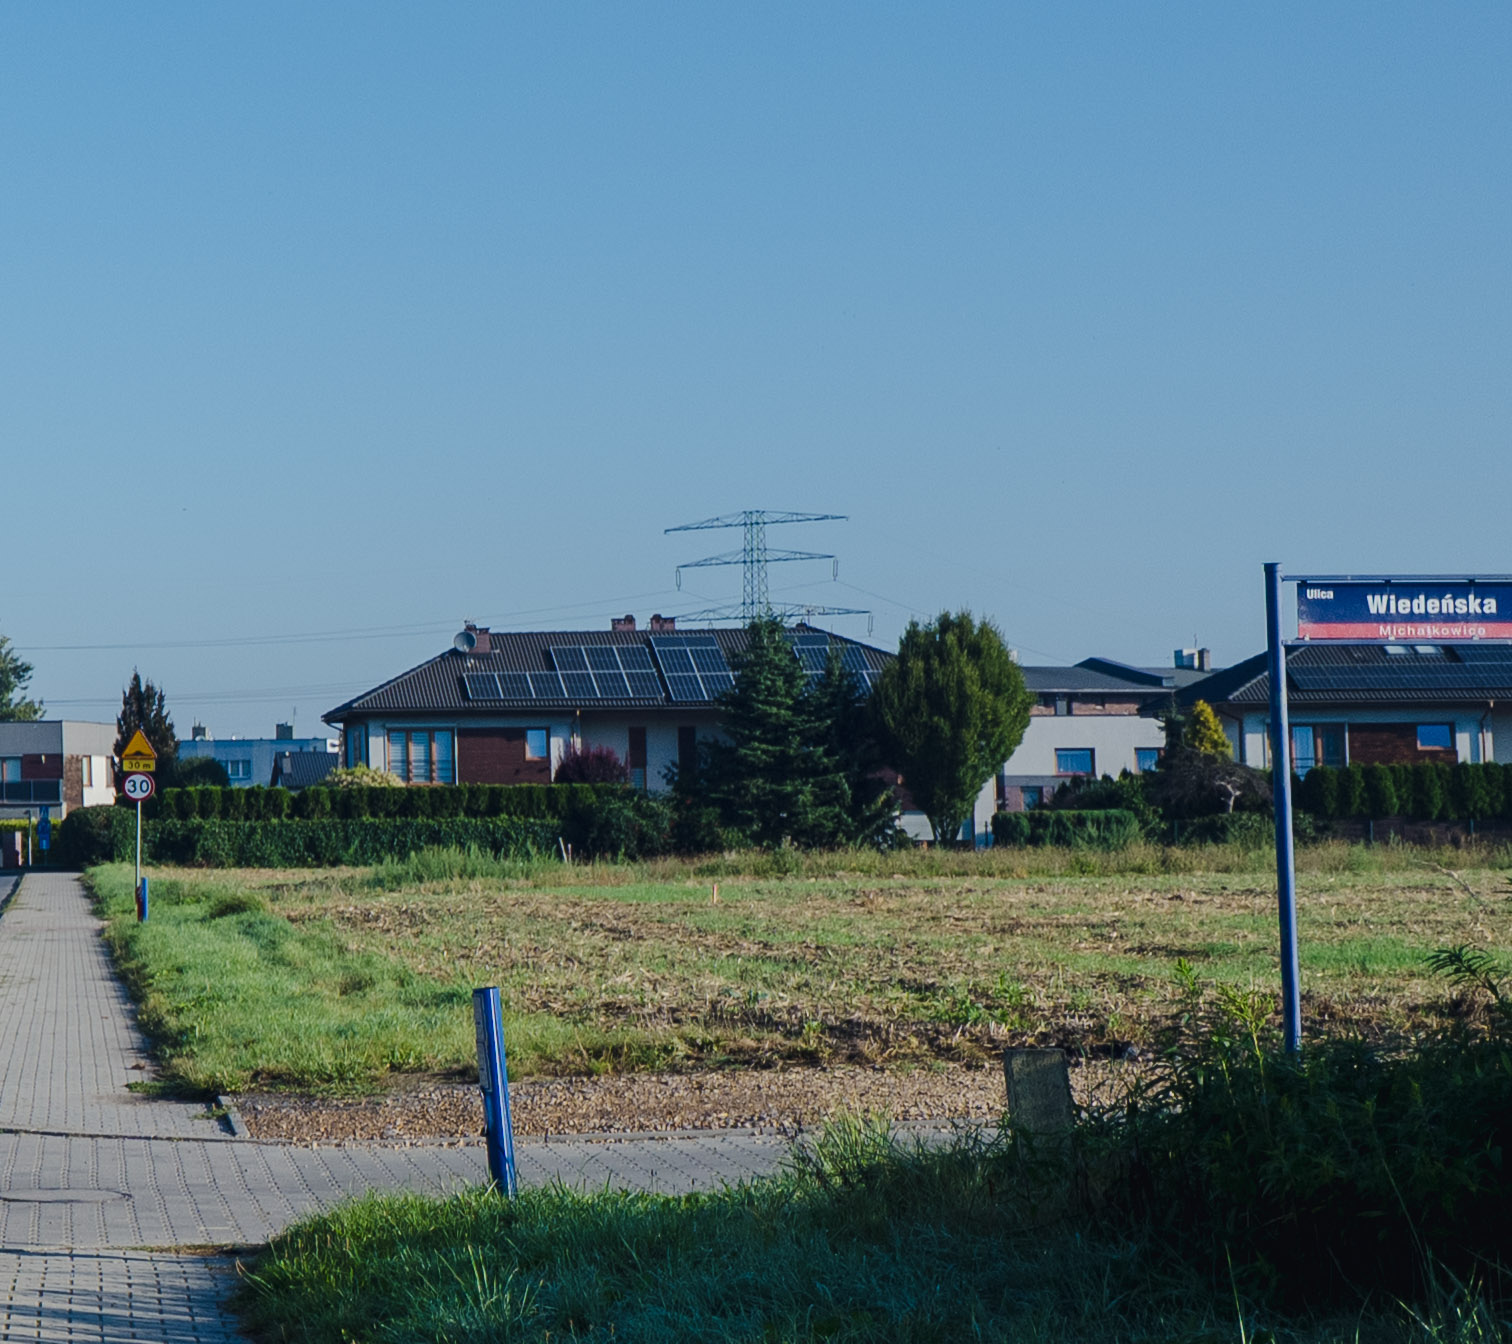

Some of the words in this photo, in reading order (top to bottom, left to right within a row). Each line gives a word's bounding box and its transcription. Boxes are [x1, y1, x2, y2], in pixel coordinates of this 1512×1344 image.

[1306, 588, 1334, 600] Ulica
[1366, 593, 1497, 614] Wiedeńska
[128, 761, 140, 769] 30
[127, 779, 150, 793] 30
